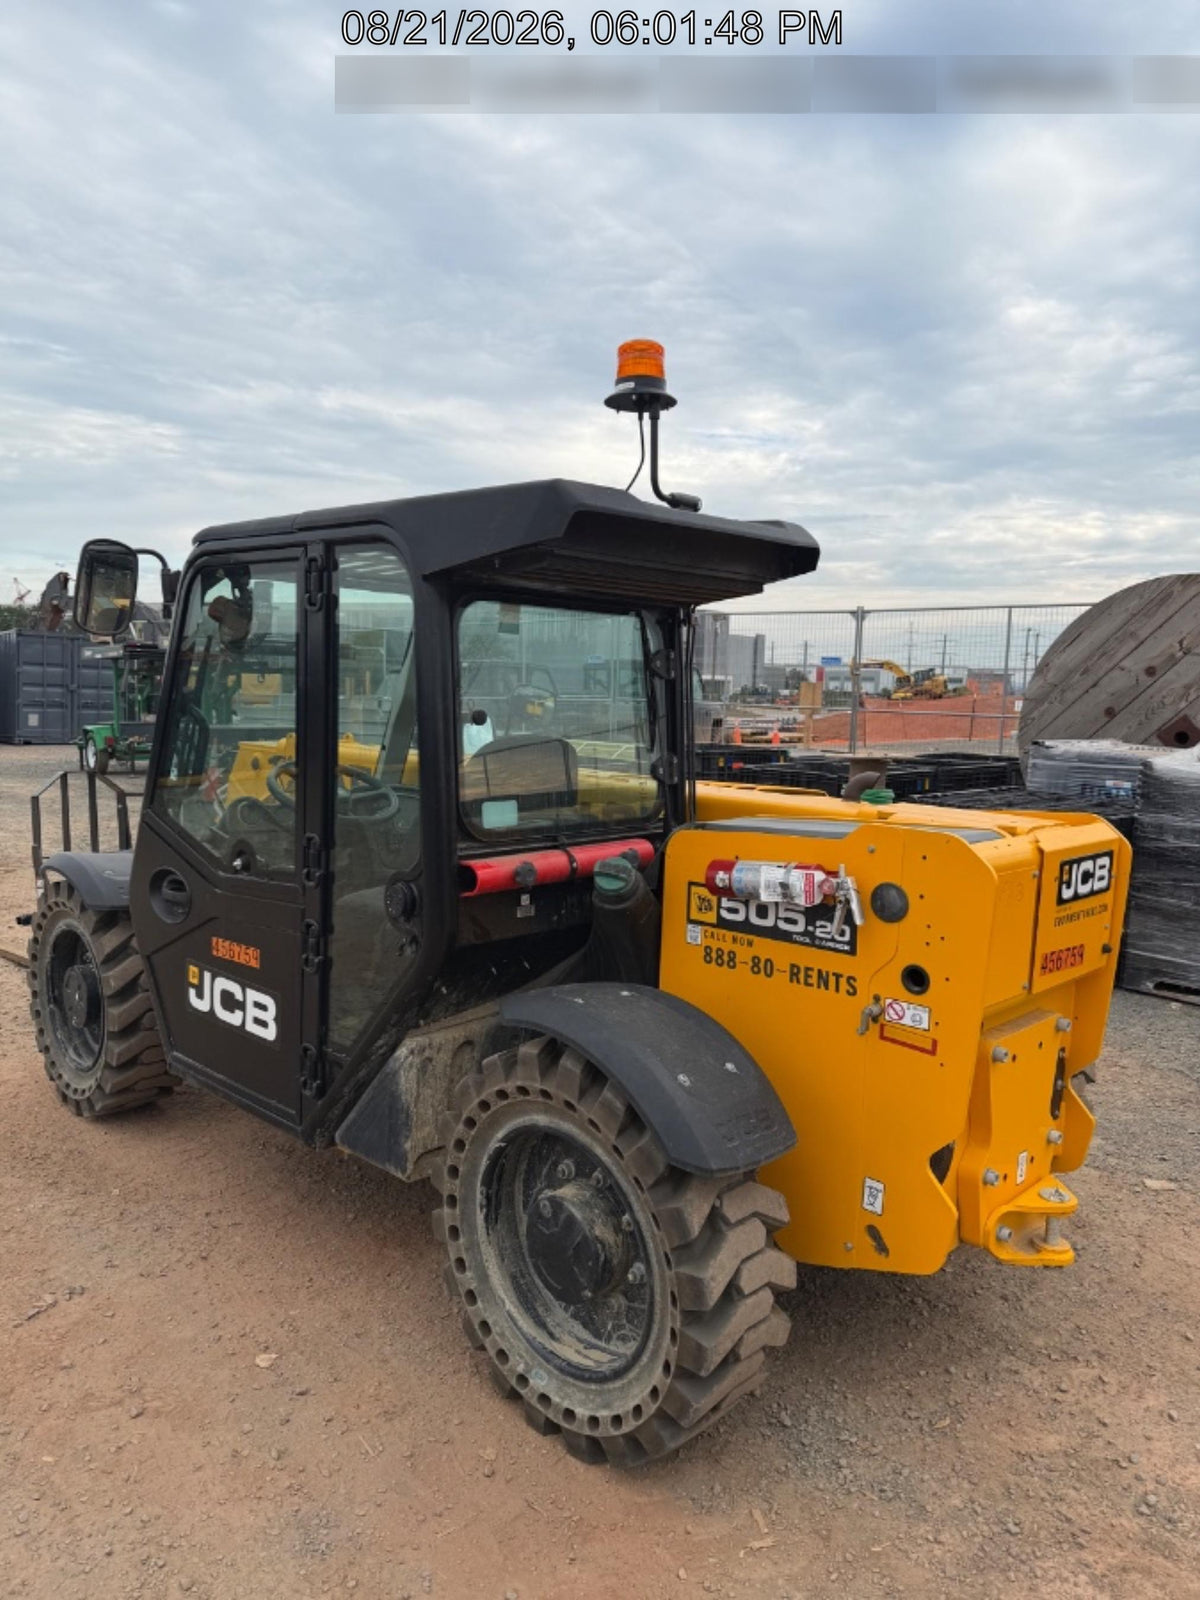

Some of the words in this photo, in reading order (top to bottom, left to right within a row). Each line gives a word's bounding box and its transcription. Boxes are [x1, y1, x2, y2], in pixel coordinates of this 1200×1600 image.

[1061, 856, 1110, 900] JCB
[703, 929, 728, 943] CALL
[731, 934, 754, 948] NOW
[703, 945, 858, 997] 888-80-RENTS
[188, 970, 277, 1041] JCB
